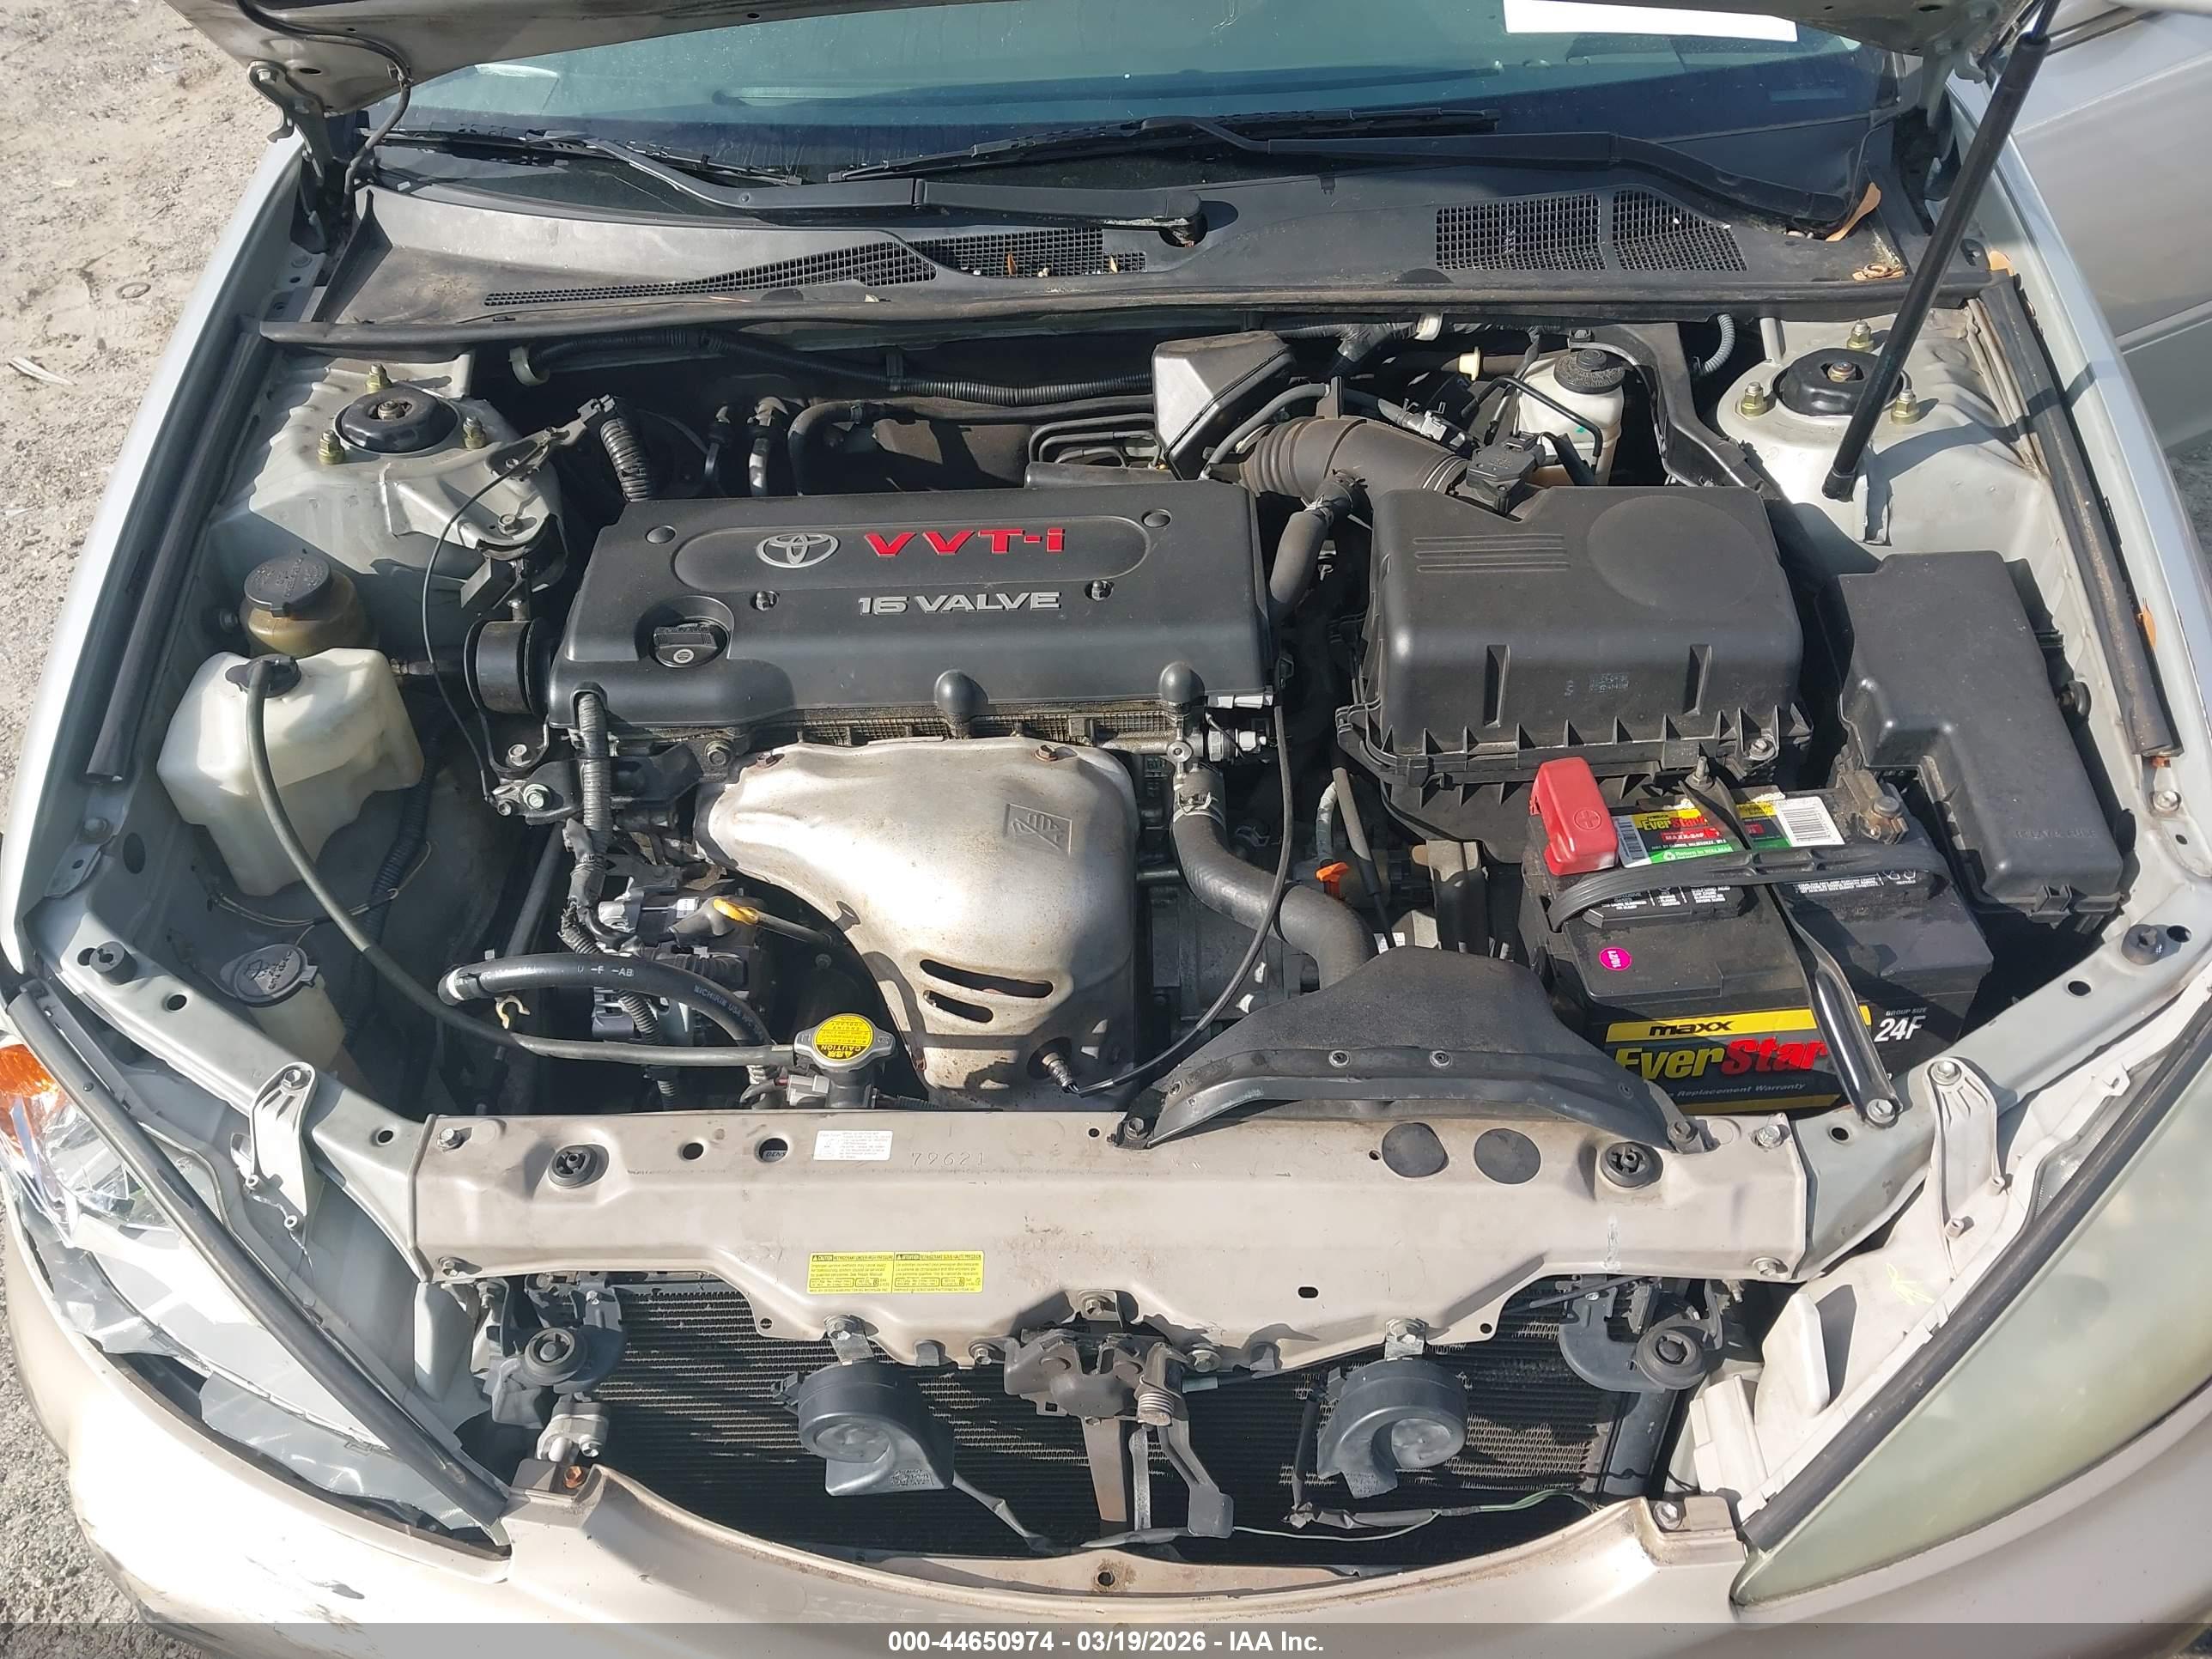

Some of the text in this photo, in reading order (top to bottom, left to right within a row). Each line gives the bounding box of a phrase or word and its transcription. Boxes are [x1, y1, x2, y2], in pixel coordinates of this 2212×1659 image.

[864, 528, 1065, 556] VVT-i
[858, 592, 1061, 616] 16 VALVE
[1649, 1020, 1735, 1036] maxx
[1874, 1015, 1926, 1042] 24F
[1614, 1036, 1829, 1080] EverStar
[1677, 1085, 1752, 1097] Replacement
[1755, 1082, 1806, 1092] Warranty
